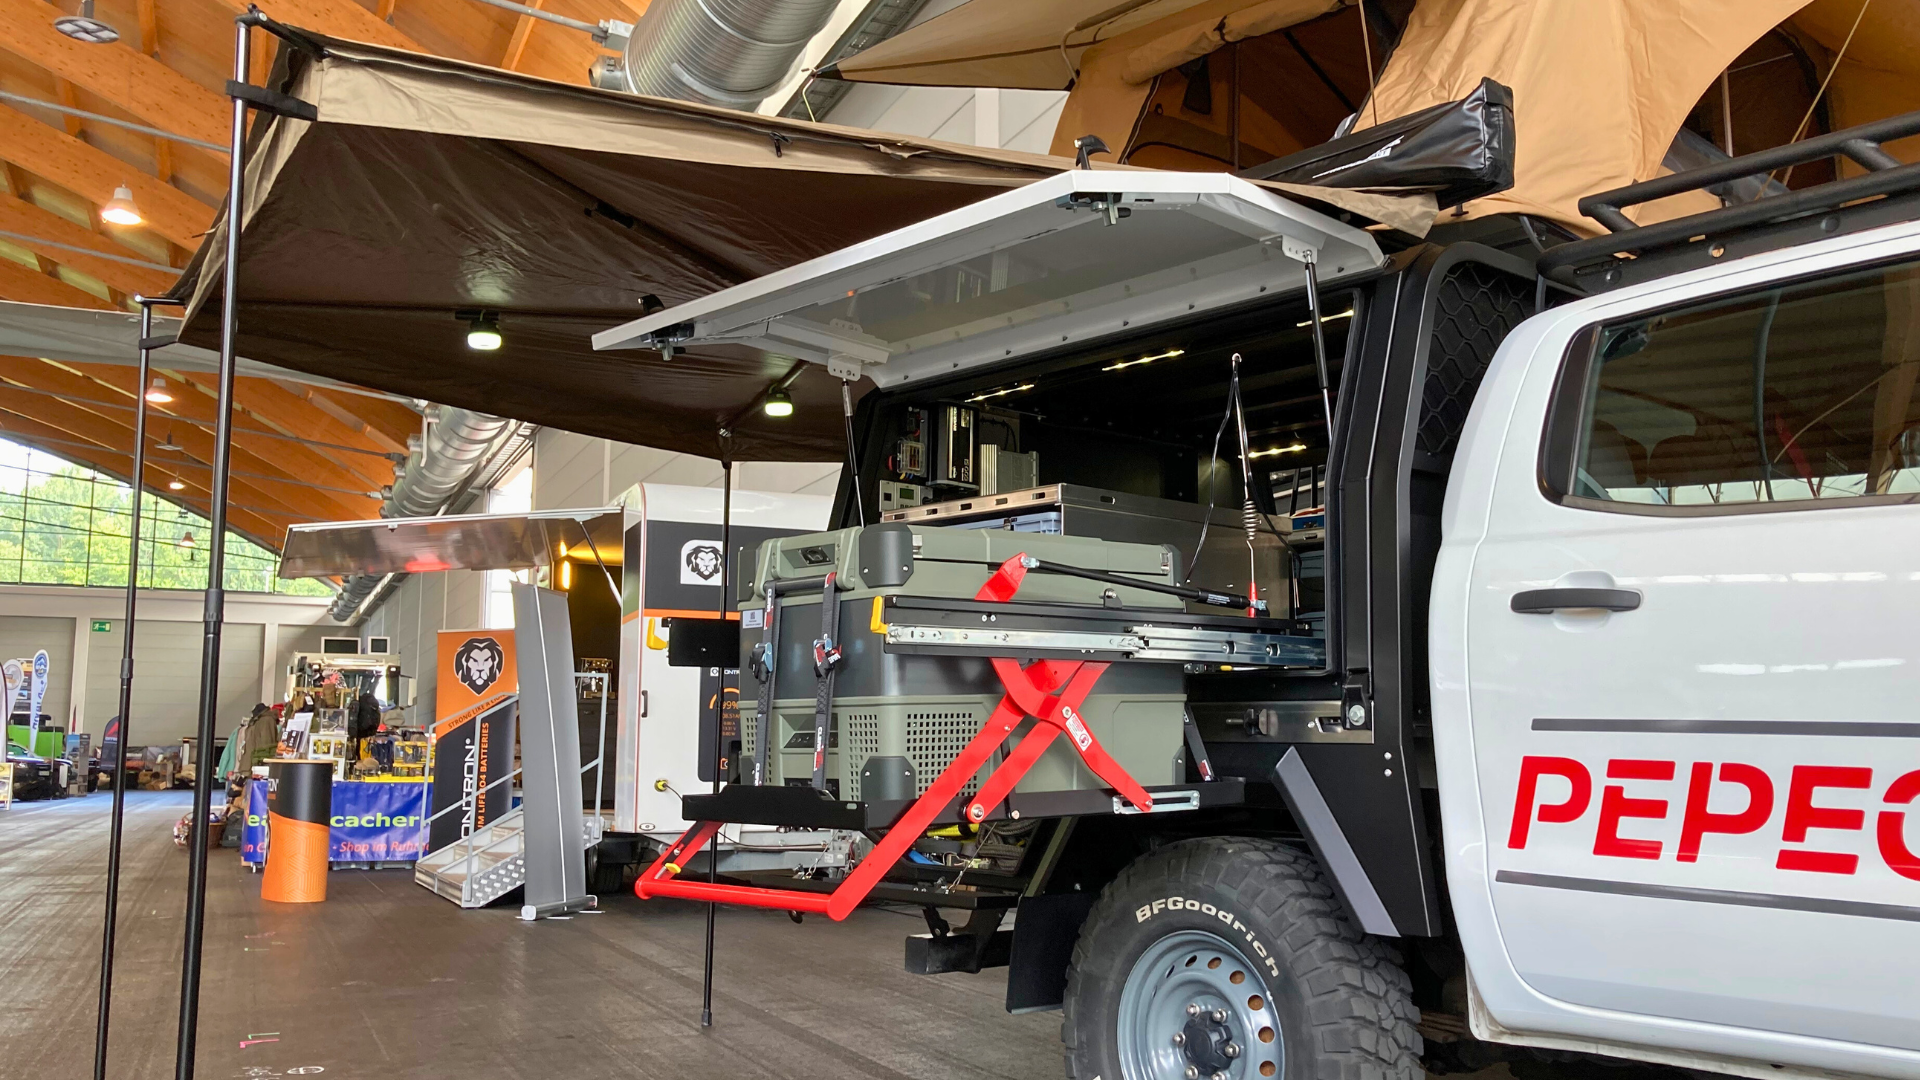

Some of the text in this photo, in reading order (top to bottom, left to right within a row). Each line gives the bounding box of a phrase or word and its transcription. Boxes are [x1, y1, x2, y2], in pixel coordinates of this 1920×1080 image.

[447, 711, 472, 730] STRONG
[480, 722, 490, 773] BATTERIES
[339, 841, 370, 856] Shop
[371, 842, 388, 852] im
[1135, 896, 1281, 978] BFGoodrich
